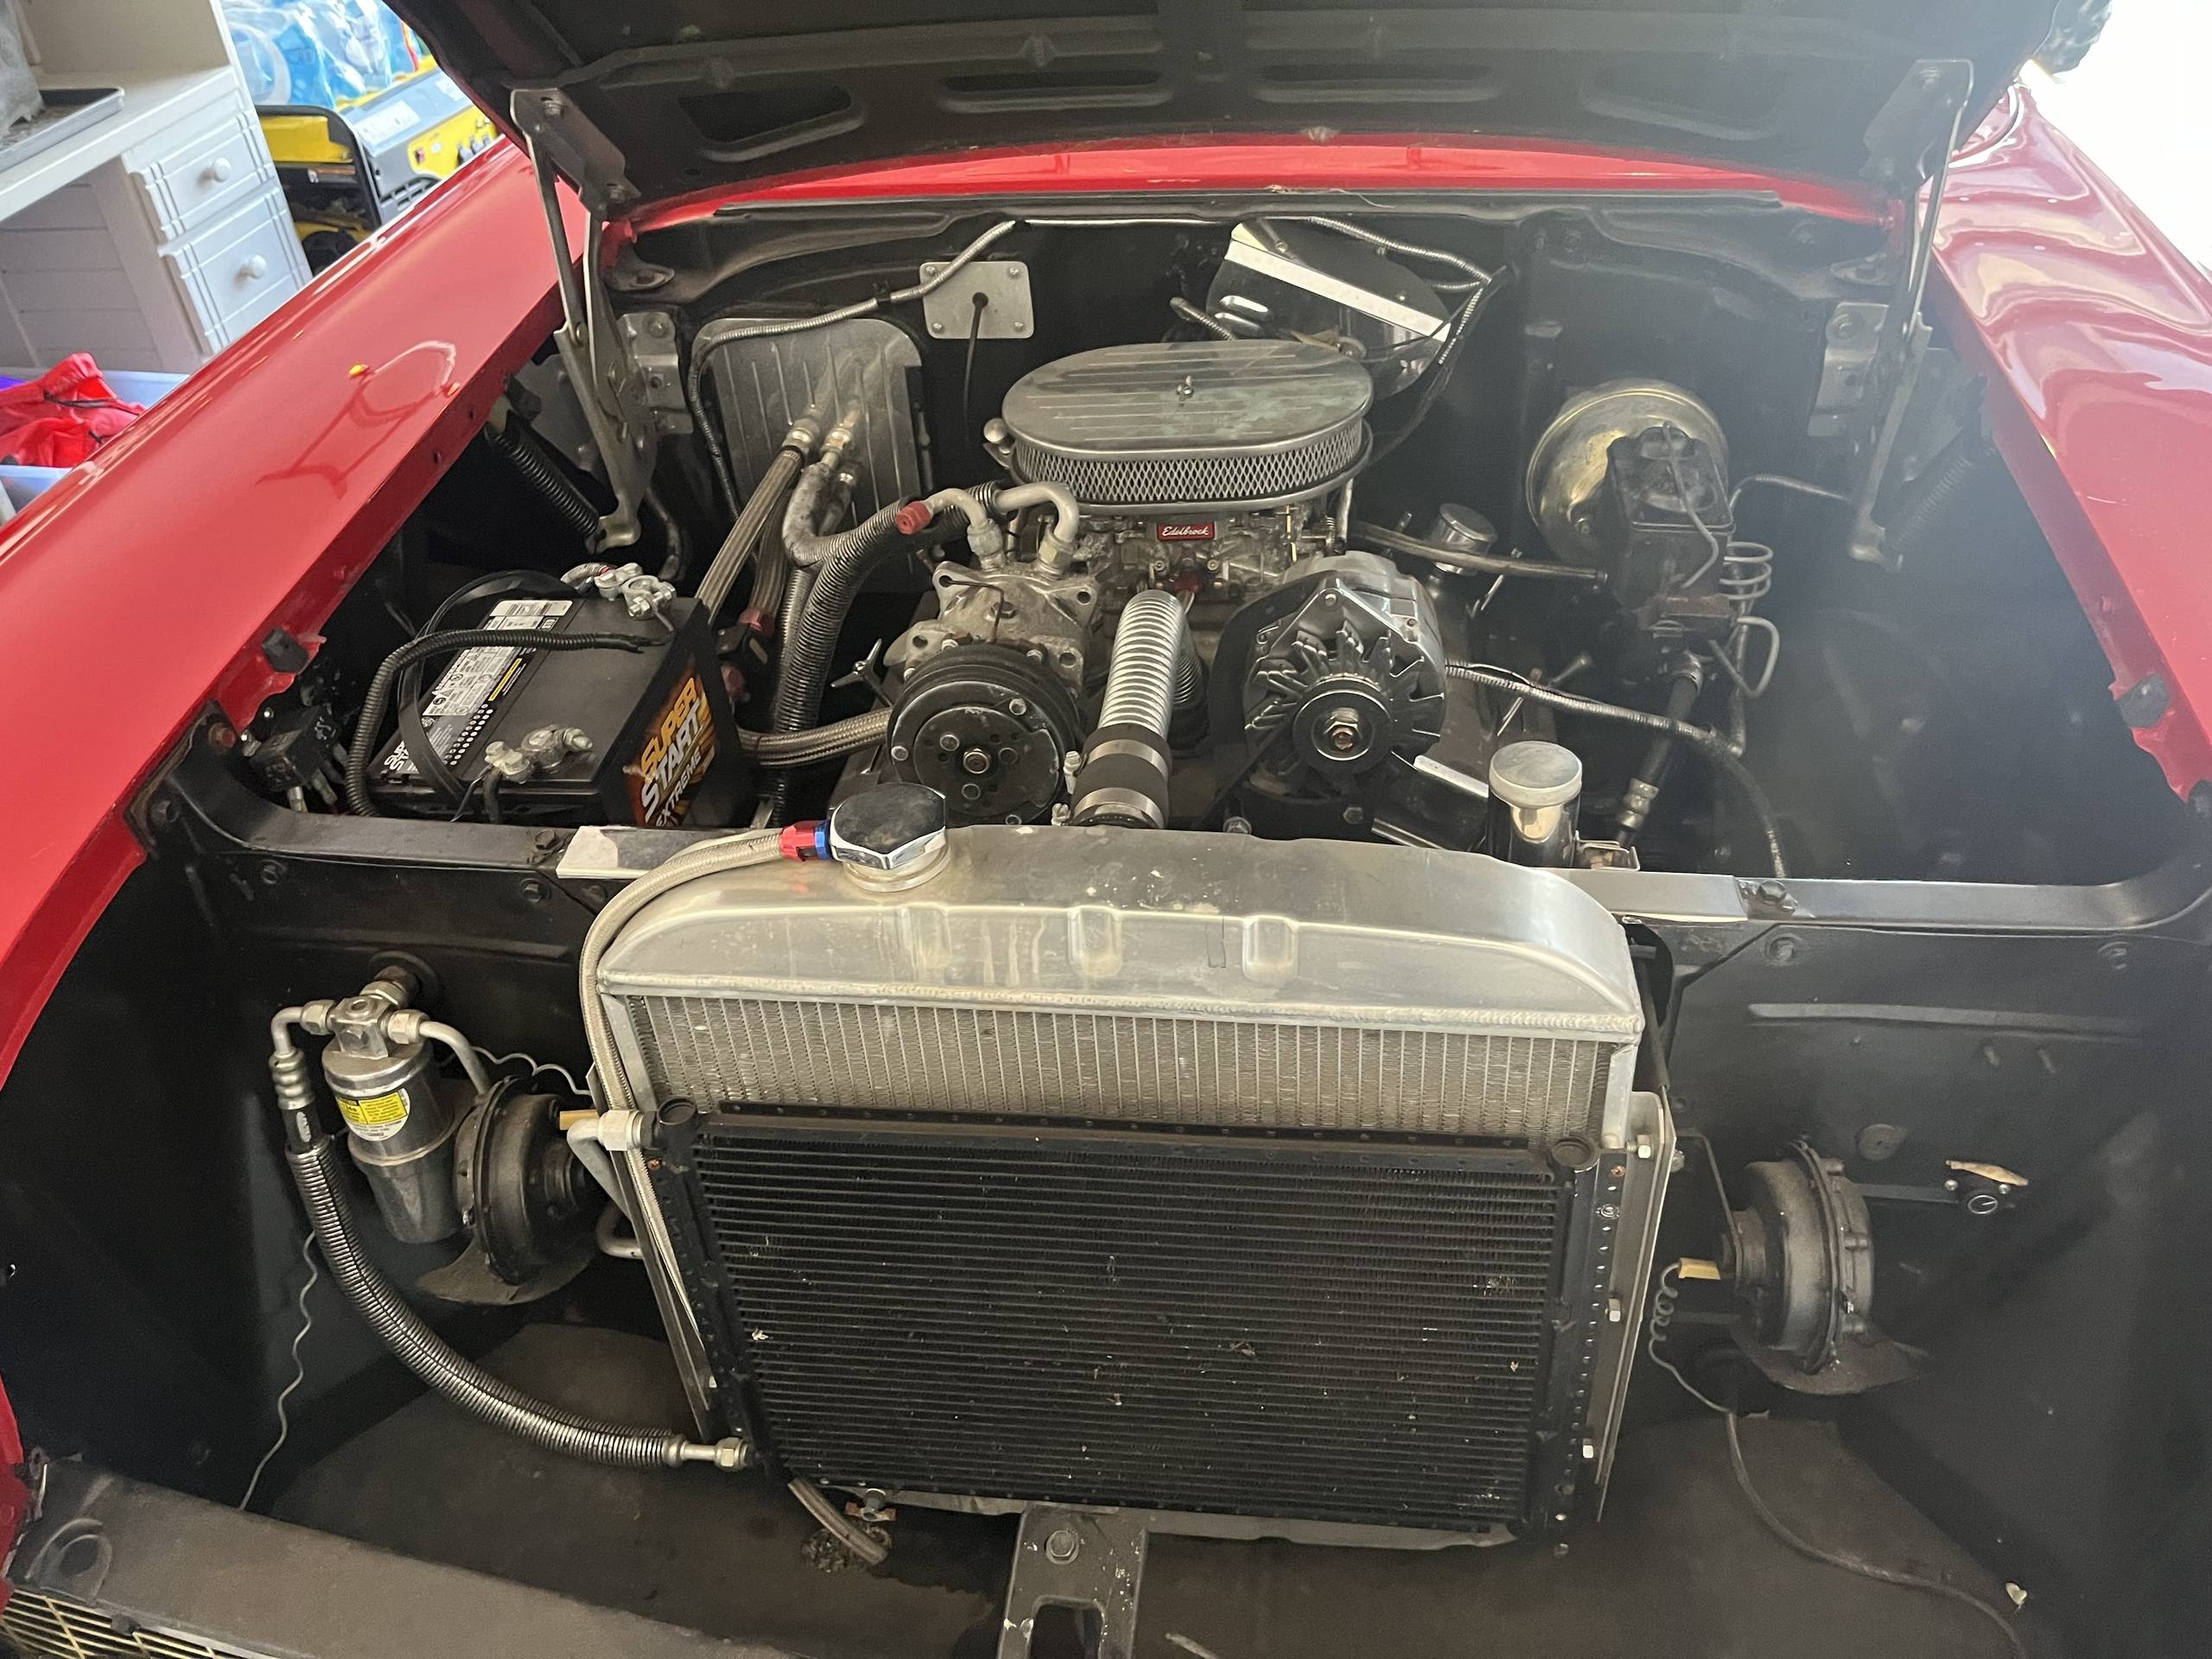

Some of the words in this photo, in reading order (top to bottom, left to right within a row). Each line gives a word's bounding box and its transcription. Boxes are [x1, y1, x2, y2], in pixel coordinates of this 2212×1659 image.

[1161, 525, 1210, 537] Edelbrock
[641, 677, 697, 783] SUPER
[641, 697, 701, 823] START
